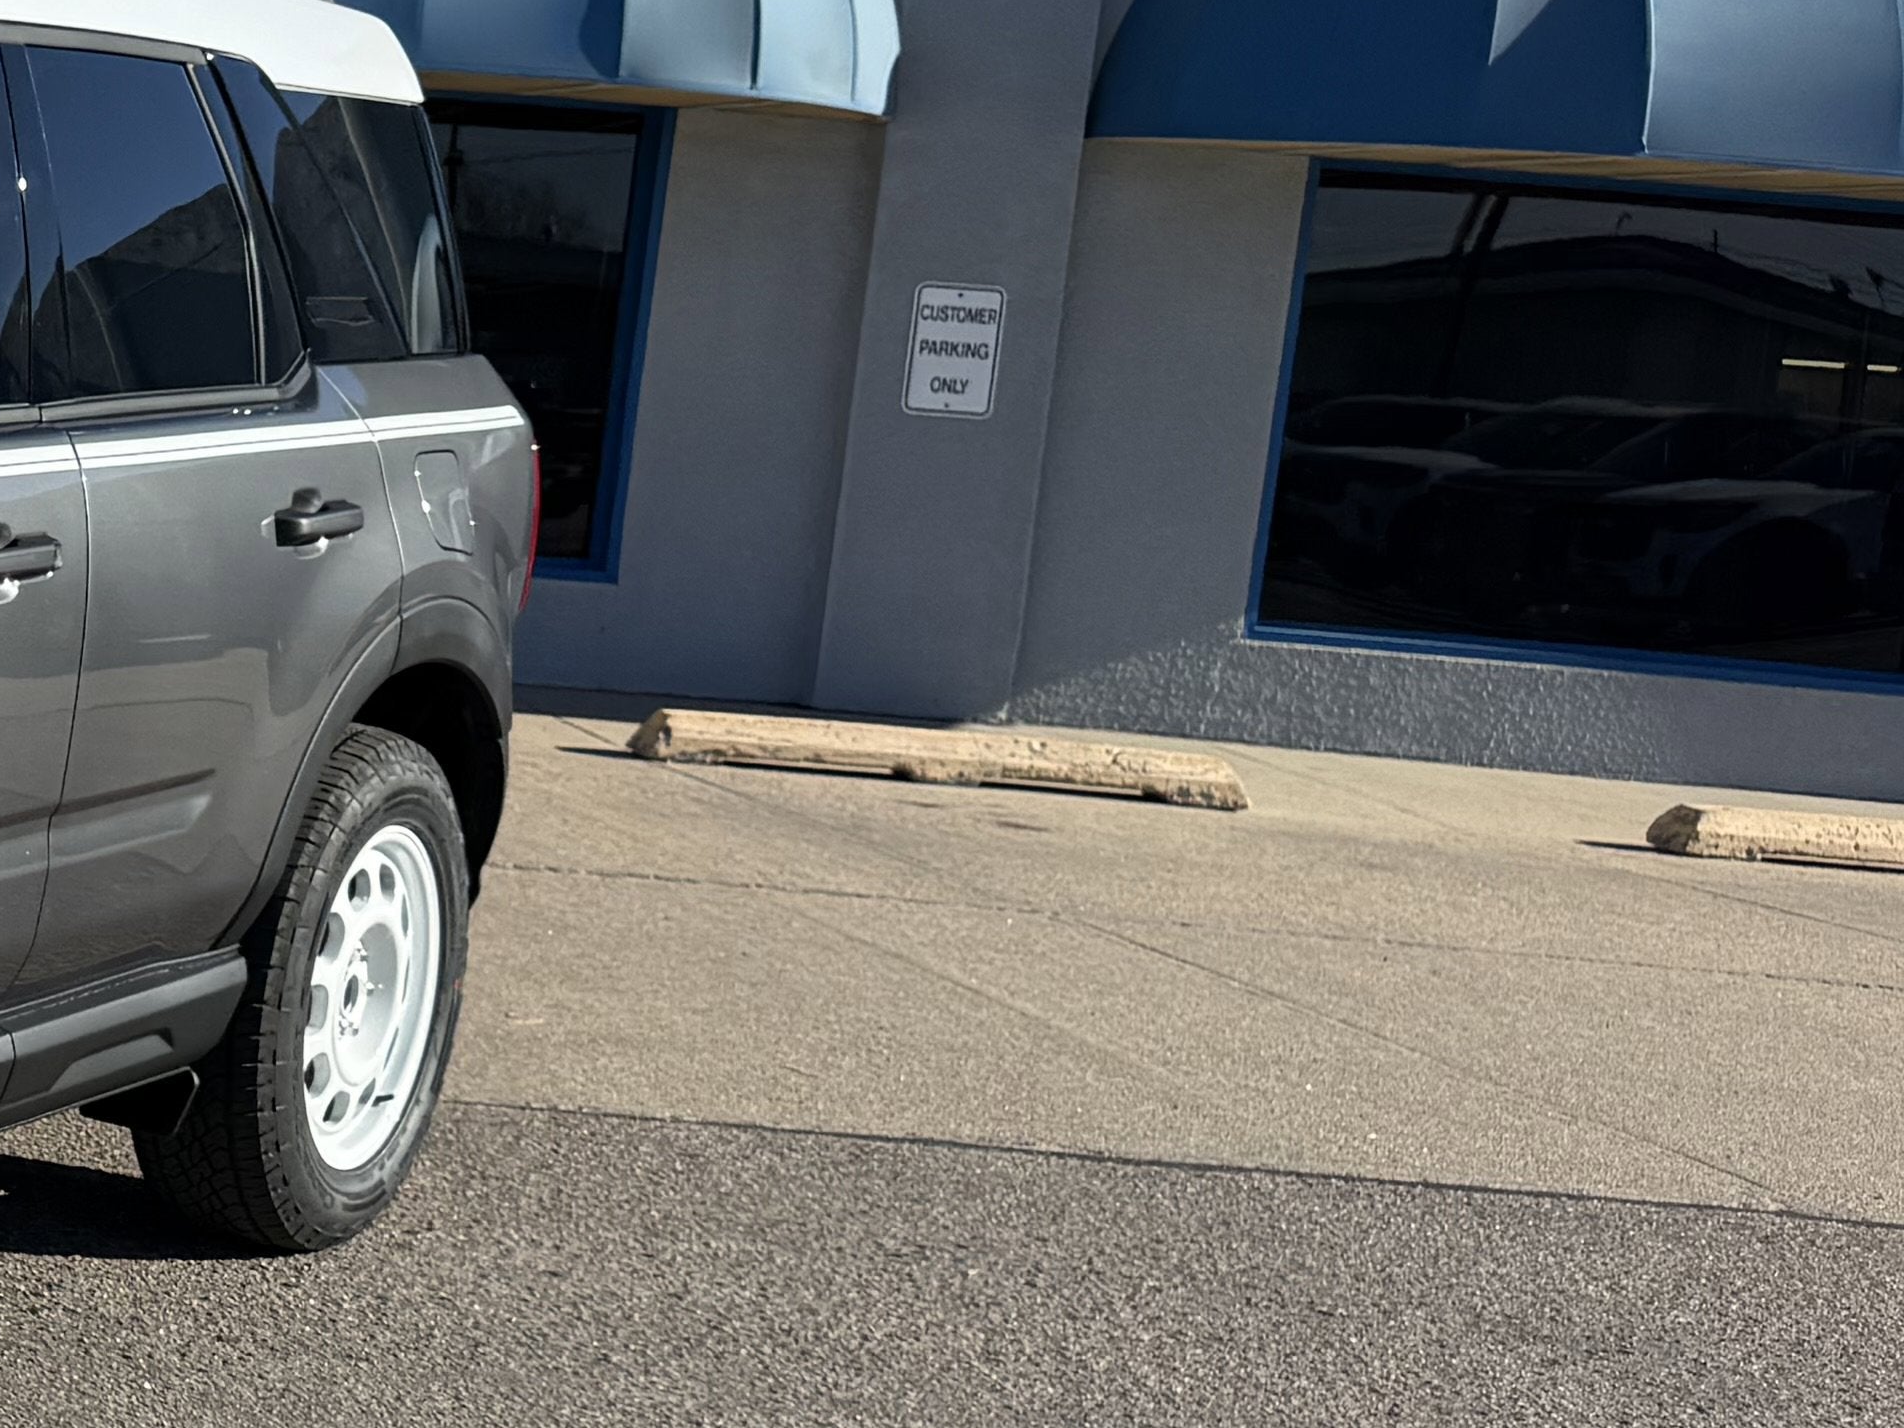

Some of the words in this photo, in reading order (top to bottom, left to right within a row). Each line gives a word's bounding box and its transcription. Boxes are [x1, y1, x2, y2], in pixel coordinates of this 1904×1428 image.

[920, 303, 998, 326] CUSTOMER
[918, 339, 990, 361] PARKING
[929, 376, 970, 395] ONLY
